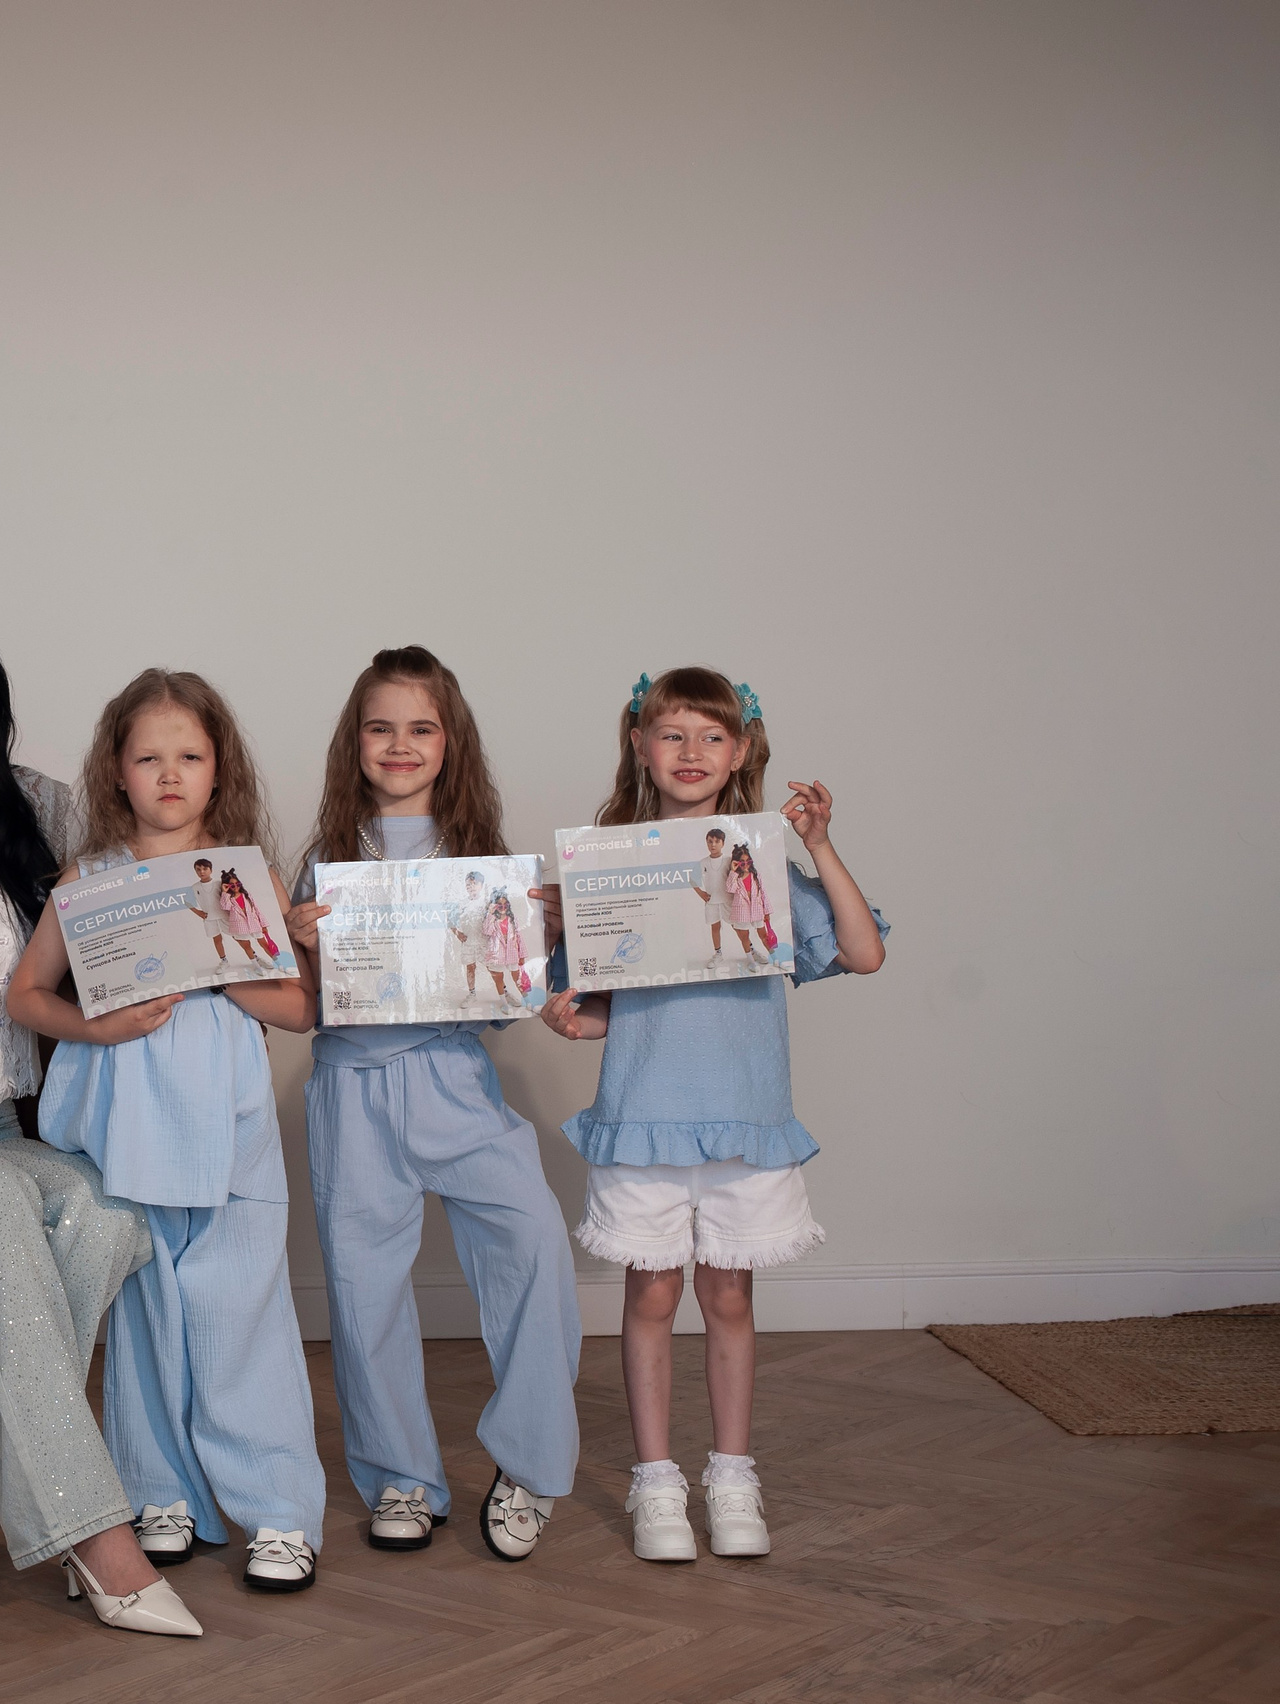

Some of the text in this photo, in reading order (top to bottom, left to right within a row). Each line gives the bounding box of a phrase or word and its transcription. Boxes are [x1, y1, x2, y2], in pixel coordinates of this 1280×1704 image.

[574, 869, 693, 892] СЕРТИФИКАТ
[74, 893, 187, 933] СЕРТИФИКАТ
[332, 909, 451, 926] СЕРТИФИКАТ
[105, 947, 127, 956] УРОВЕНЬ
[111, 951, 136, 961] Милана
[108, 983, 132, 993] PERSONAL
[110, 987, 135, 998] PORTFOLIO
